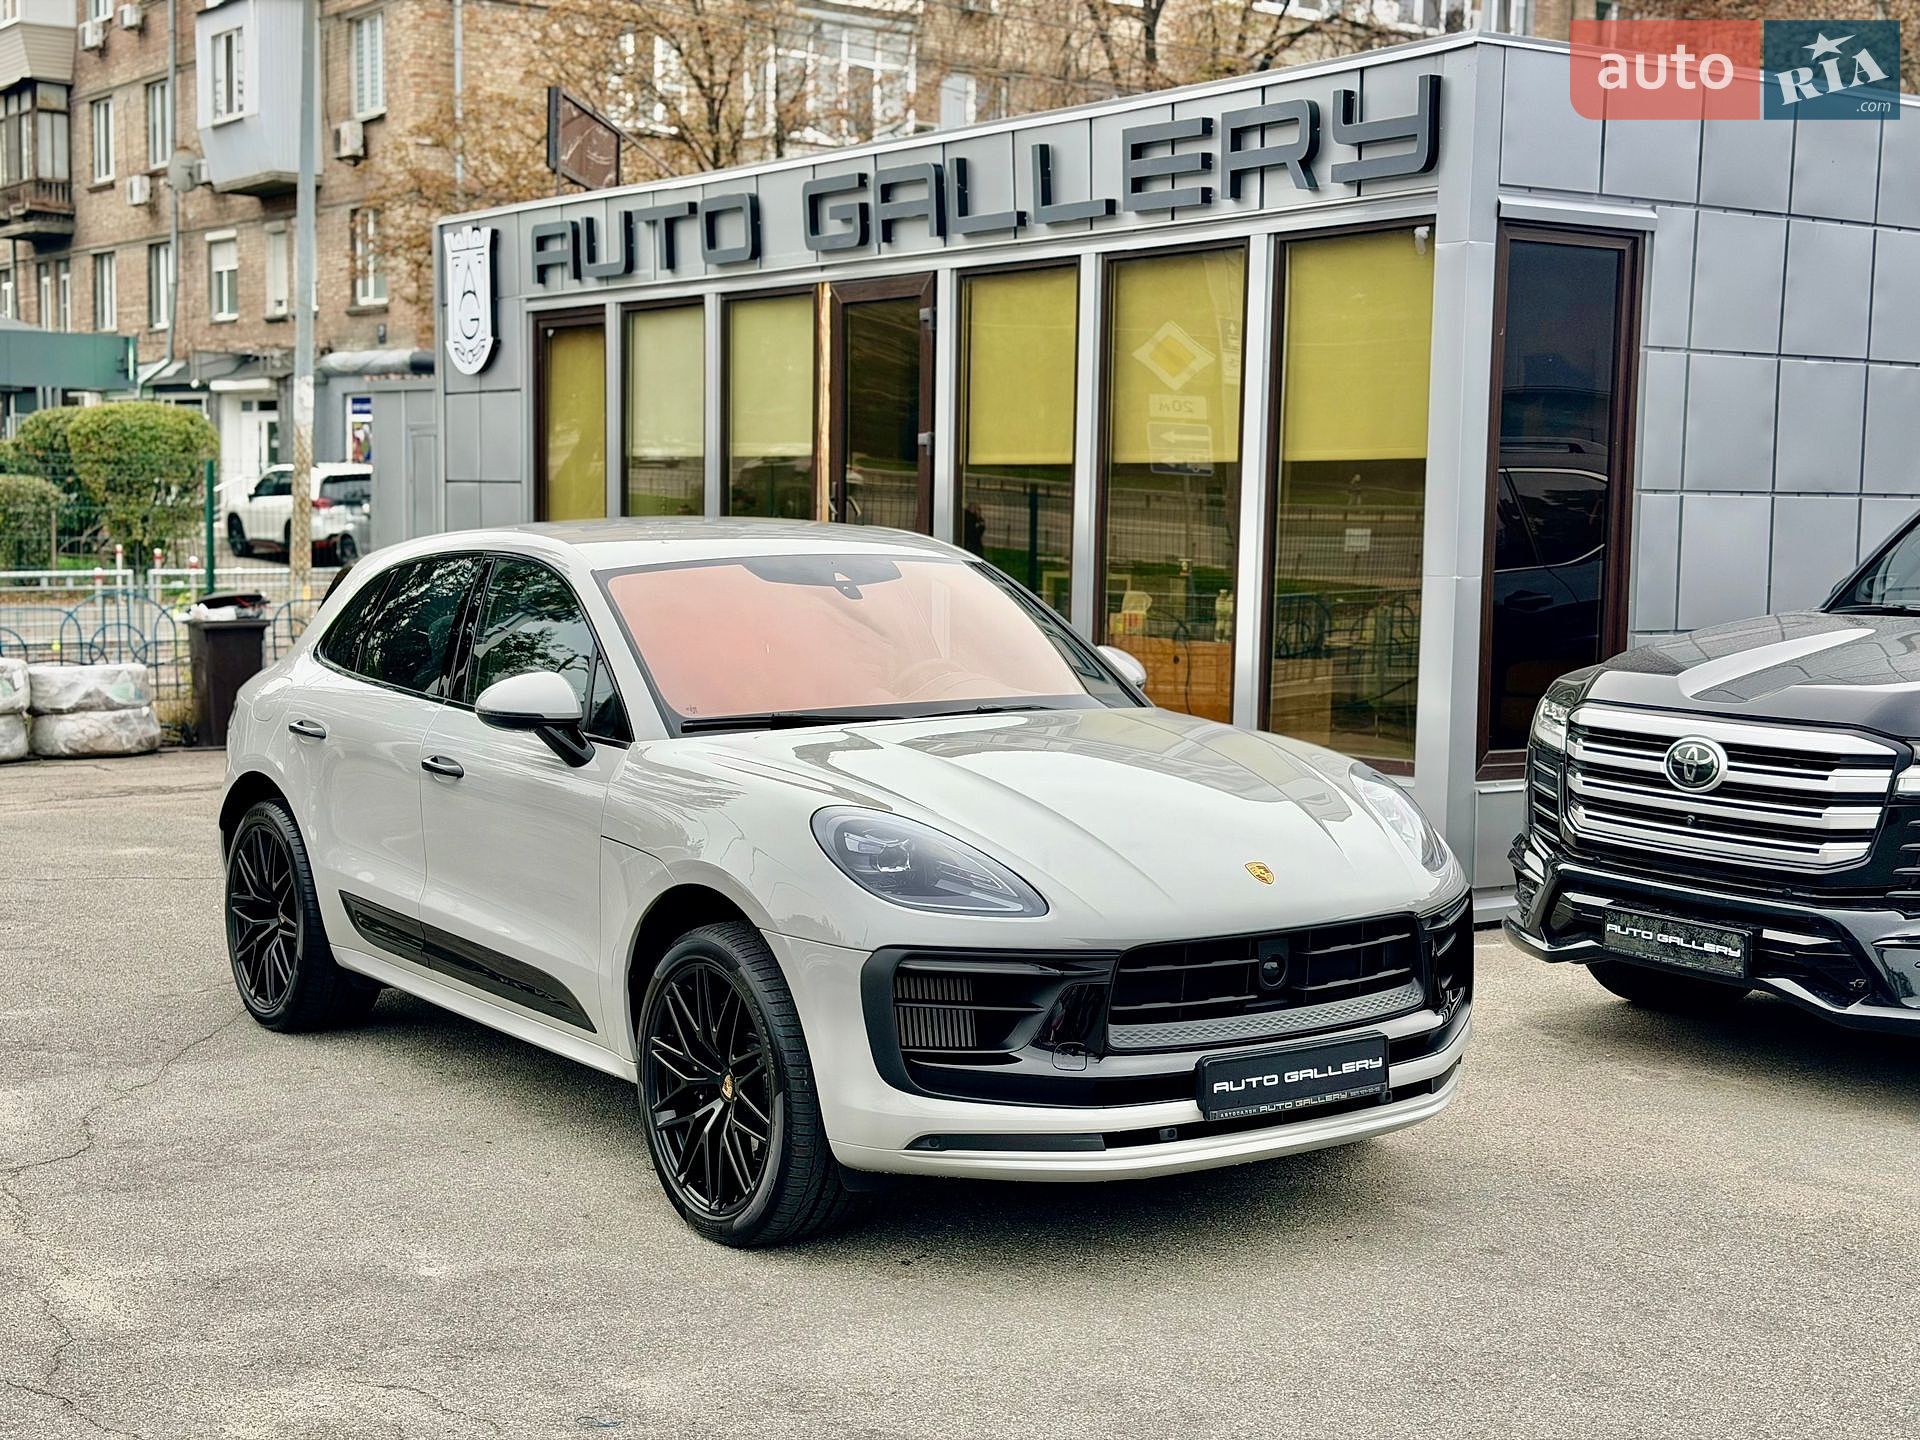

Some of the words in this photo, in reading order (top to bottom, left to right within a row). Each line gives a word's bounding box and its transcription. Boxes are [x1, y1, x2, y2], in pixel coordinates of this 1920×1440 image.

[531, 192, 761, 285] AUTO
[802, 74, 1442, 252] GALLERY
[1606, 923, 1653, 940] AUTO
[1656, 933, 1741, 958] GALLERY
[1213, 1074, 1279, 1094] AUTO
[1284, 1056, 1383, 1084] GALLERY
[1259, 1102, 1292, 1113] AUTO
[1295, 1092, 1348, 1108] GALLERY
